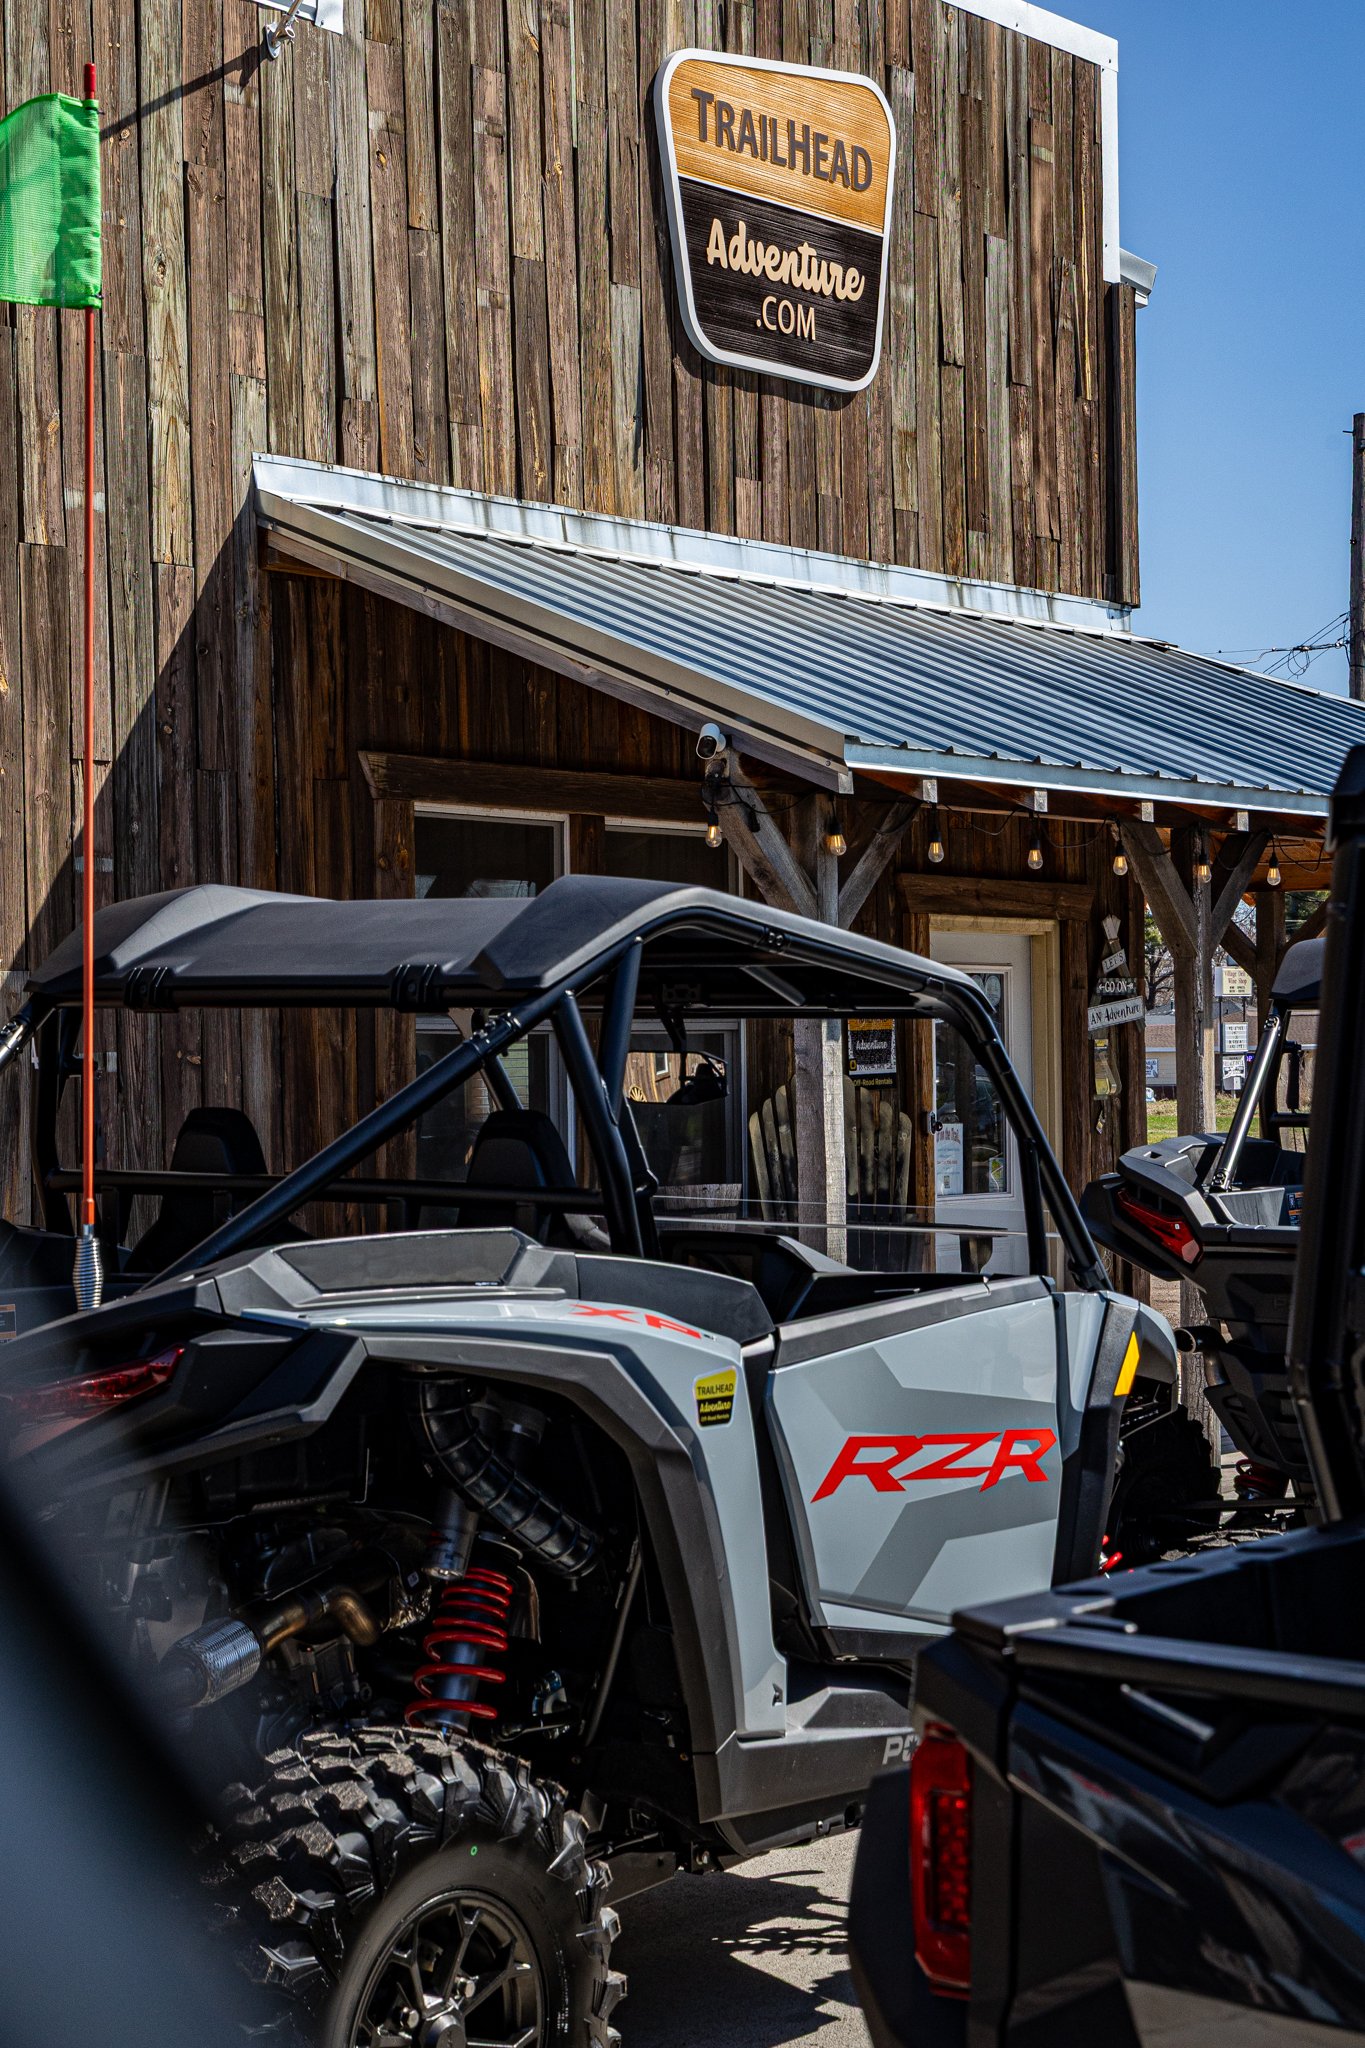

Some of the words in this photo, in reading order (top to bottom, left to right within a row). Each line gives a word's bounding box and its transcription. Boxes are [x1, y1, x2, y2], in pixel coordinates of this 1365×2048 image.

[691, 87, 873, 192] TRAILHEAD
[707, 218, 865, 301] Adventure
[756, 295, 816, 341] .COM
[1104, 952, 1124, 970] LET'S
[1104, 981, 1115, 992] GO
[1117, 980, 1127, 992] ON
[1090, 1011, 1102, 1025] AN
[1105, 1004, 1140, 1022] Adventure
[856, 1039, 888, 1051] Adventure
[697, 1383, 734, 1396] TRAILHEAD
[700, 1400, 732, 1413] Adventure
[810, 1428, 1057, 1504] RZR
